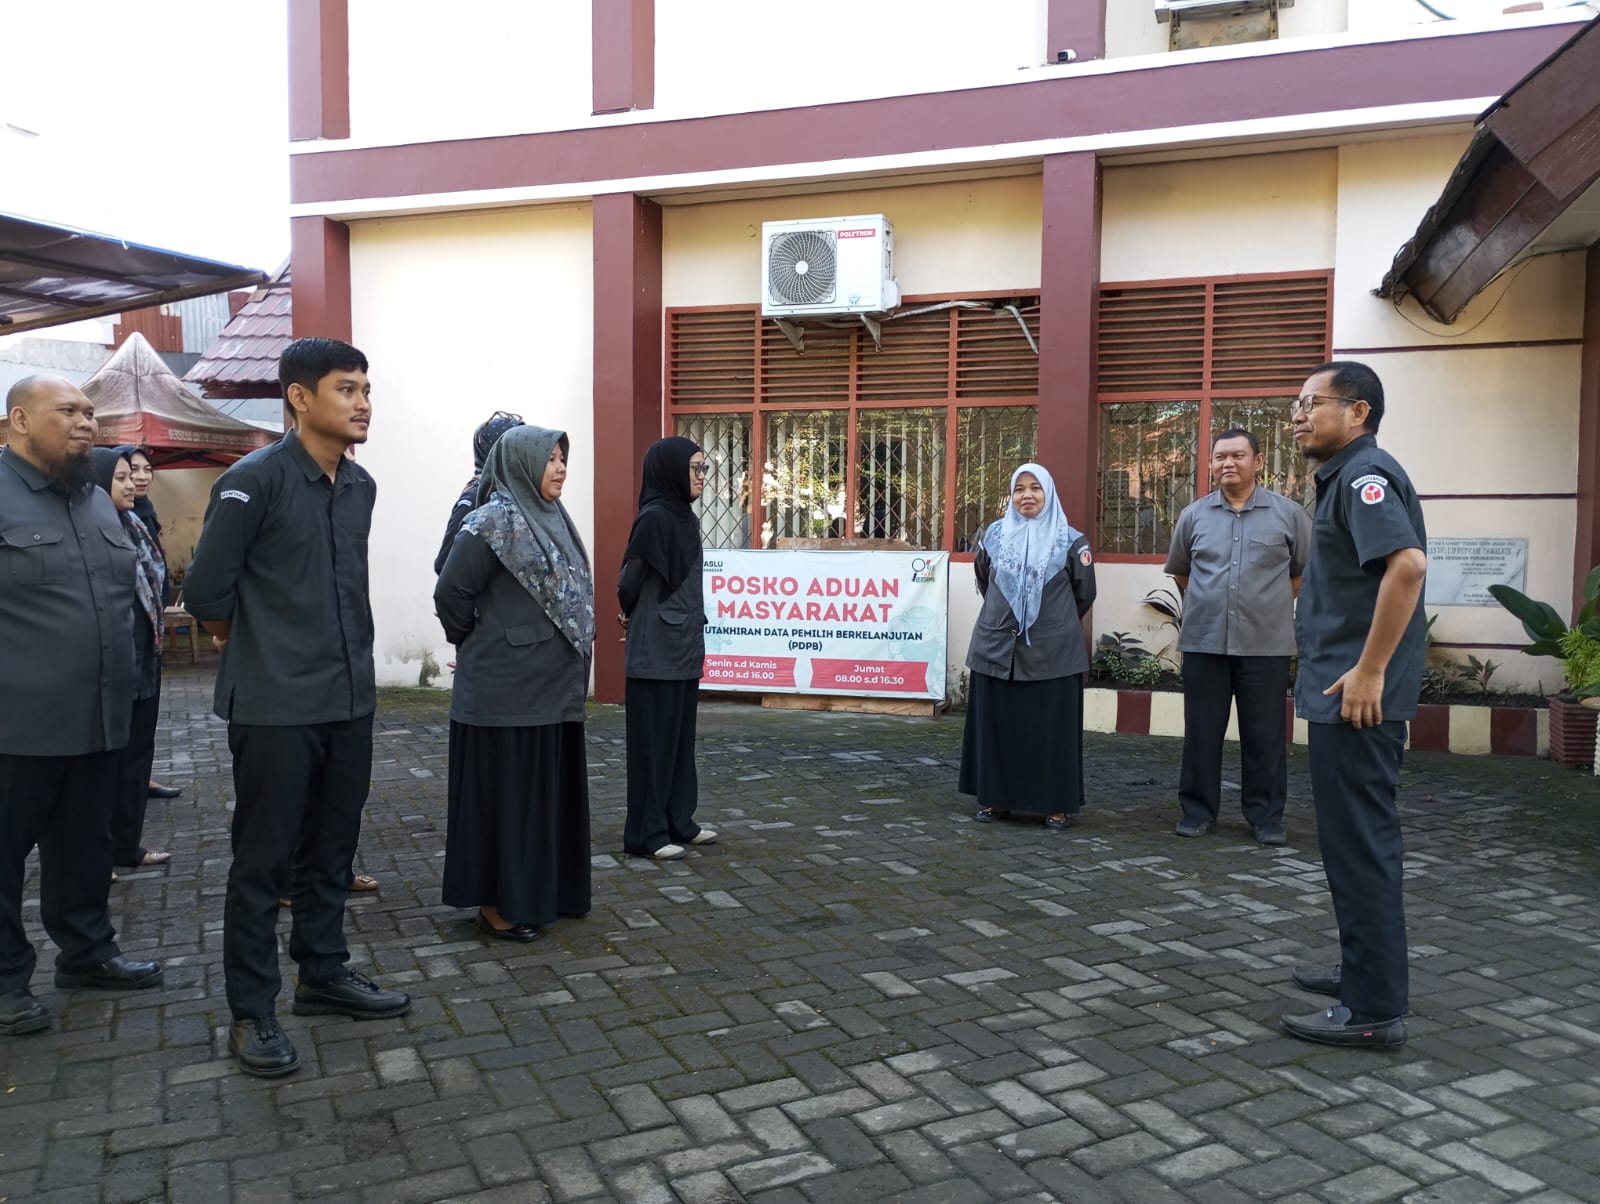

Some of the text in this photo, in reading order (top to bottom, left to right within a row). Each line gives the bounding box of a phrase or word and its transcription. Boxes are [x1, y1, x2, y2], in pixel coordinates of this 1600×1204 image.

[839, 230, 874, 238] POLYTRON
[711, 576, 899, 598] POSKO ADUAN
[717, 600, 893, 623] MASYARAKAT
[705, 626, 923, 640] UTAKHIRAN DATA PEMILIH BERKELANJUTAN
[788, 640, 823, 652] (PDPB)
[706, 659, 777, 669] Senin s.d Kamis
[853, 664, 885, 673] Jumat
[708, 669, 775, 680] 08.00 s.d 16.00
[835, 674, 904, 685] 08.00 s.d 16.30
